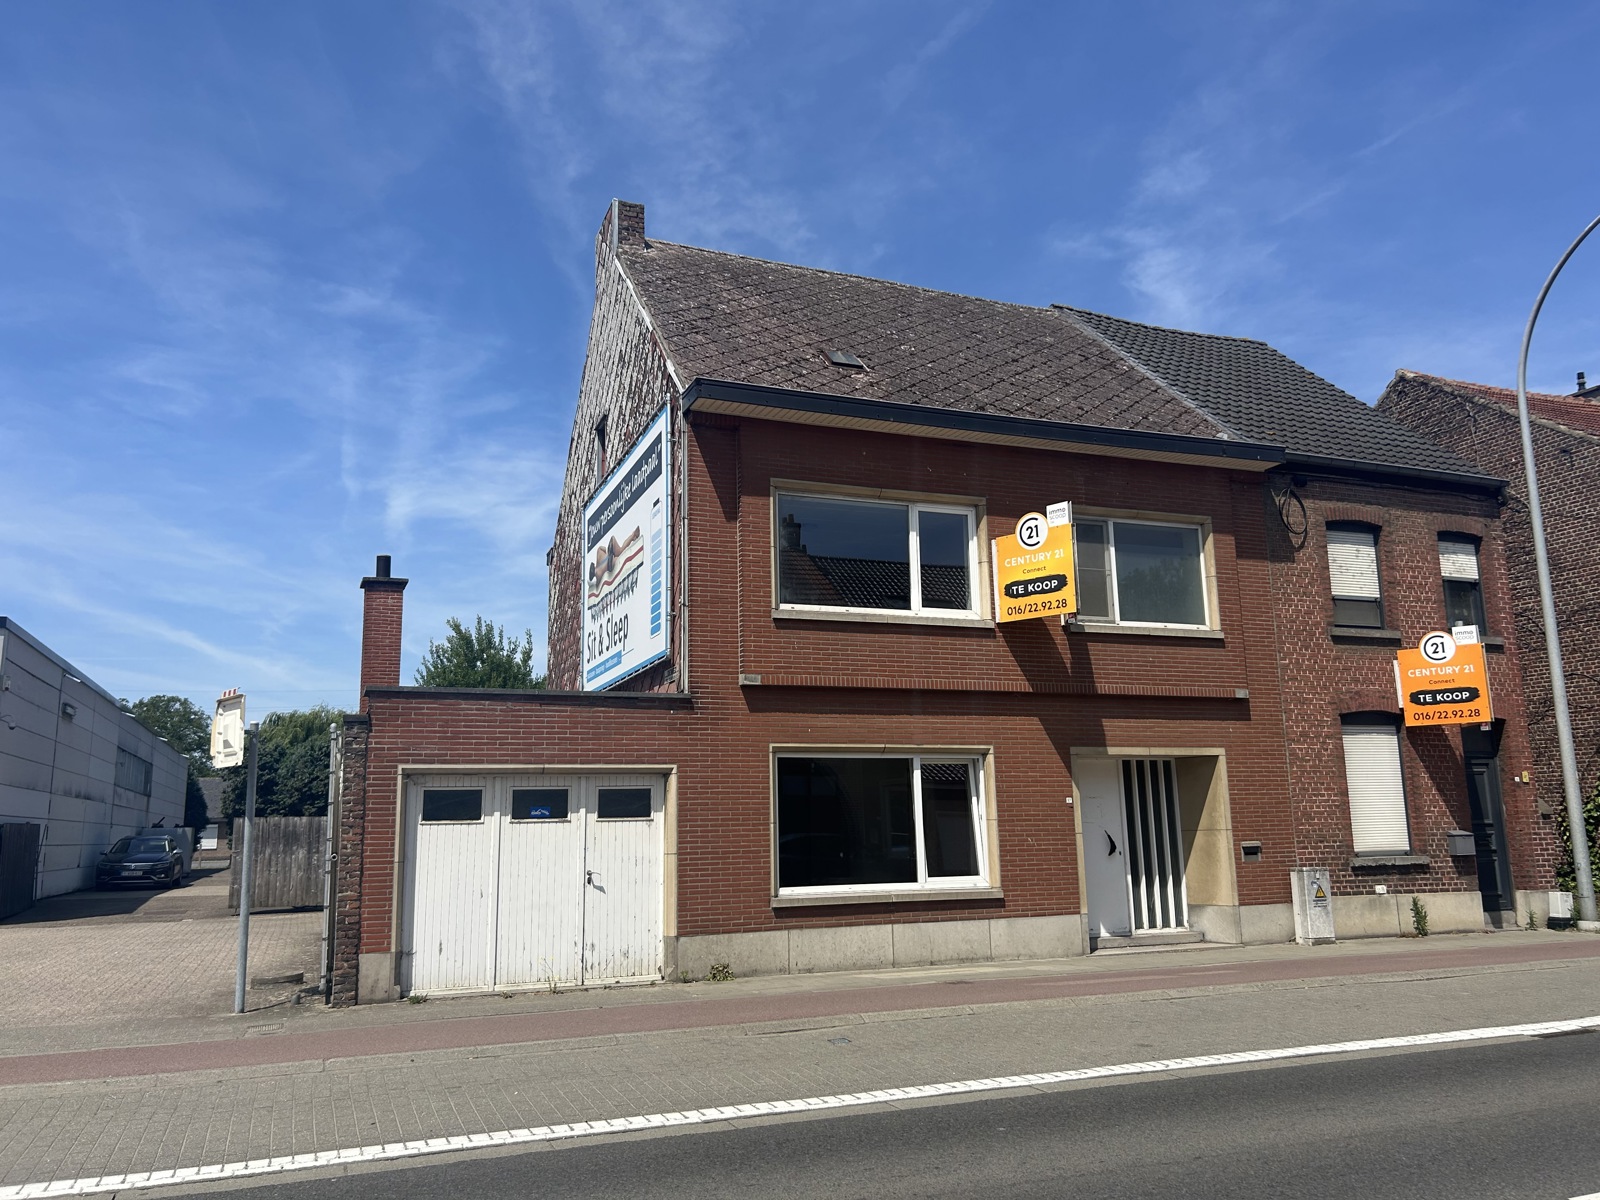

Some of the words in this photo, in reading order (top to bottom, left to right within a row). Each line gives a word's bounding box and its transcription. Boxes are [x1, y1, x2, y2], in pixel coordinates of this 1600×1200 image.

[1049, 507, 1066, 515] immo
[1005, 552, 1052, 567] CENTURY
[1055, 549, 1064, 558] 21
[1022, 566, 1047, 574] Connect
[1011, 585, 1025, 595] TE
[1027, 580, 1058, 592] KOOP
[1007, 599, 1067, 615] 016/22.92.28
[587, 630, 597, 664] Sit
[598, 623, 604, 656] &
[606, 613, 629, 652] Sleep
[1408, 666, 1461, 677] CENTURY
[1464, 665, 1474, 673] 21
[1418, 694, 1433, 703] TE
[1436, 691, 1470, 702] KOOP
[1414, 709, 1480, 720] 016/22.92.28
